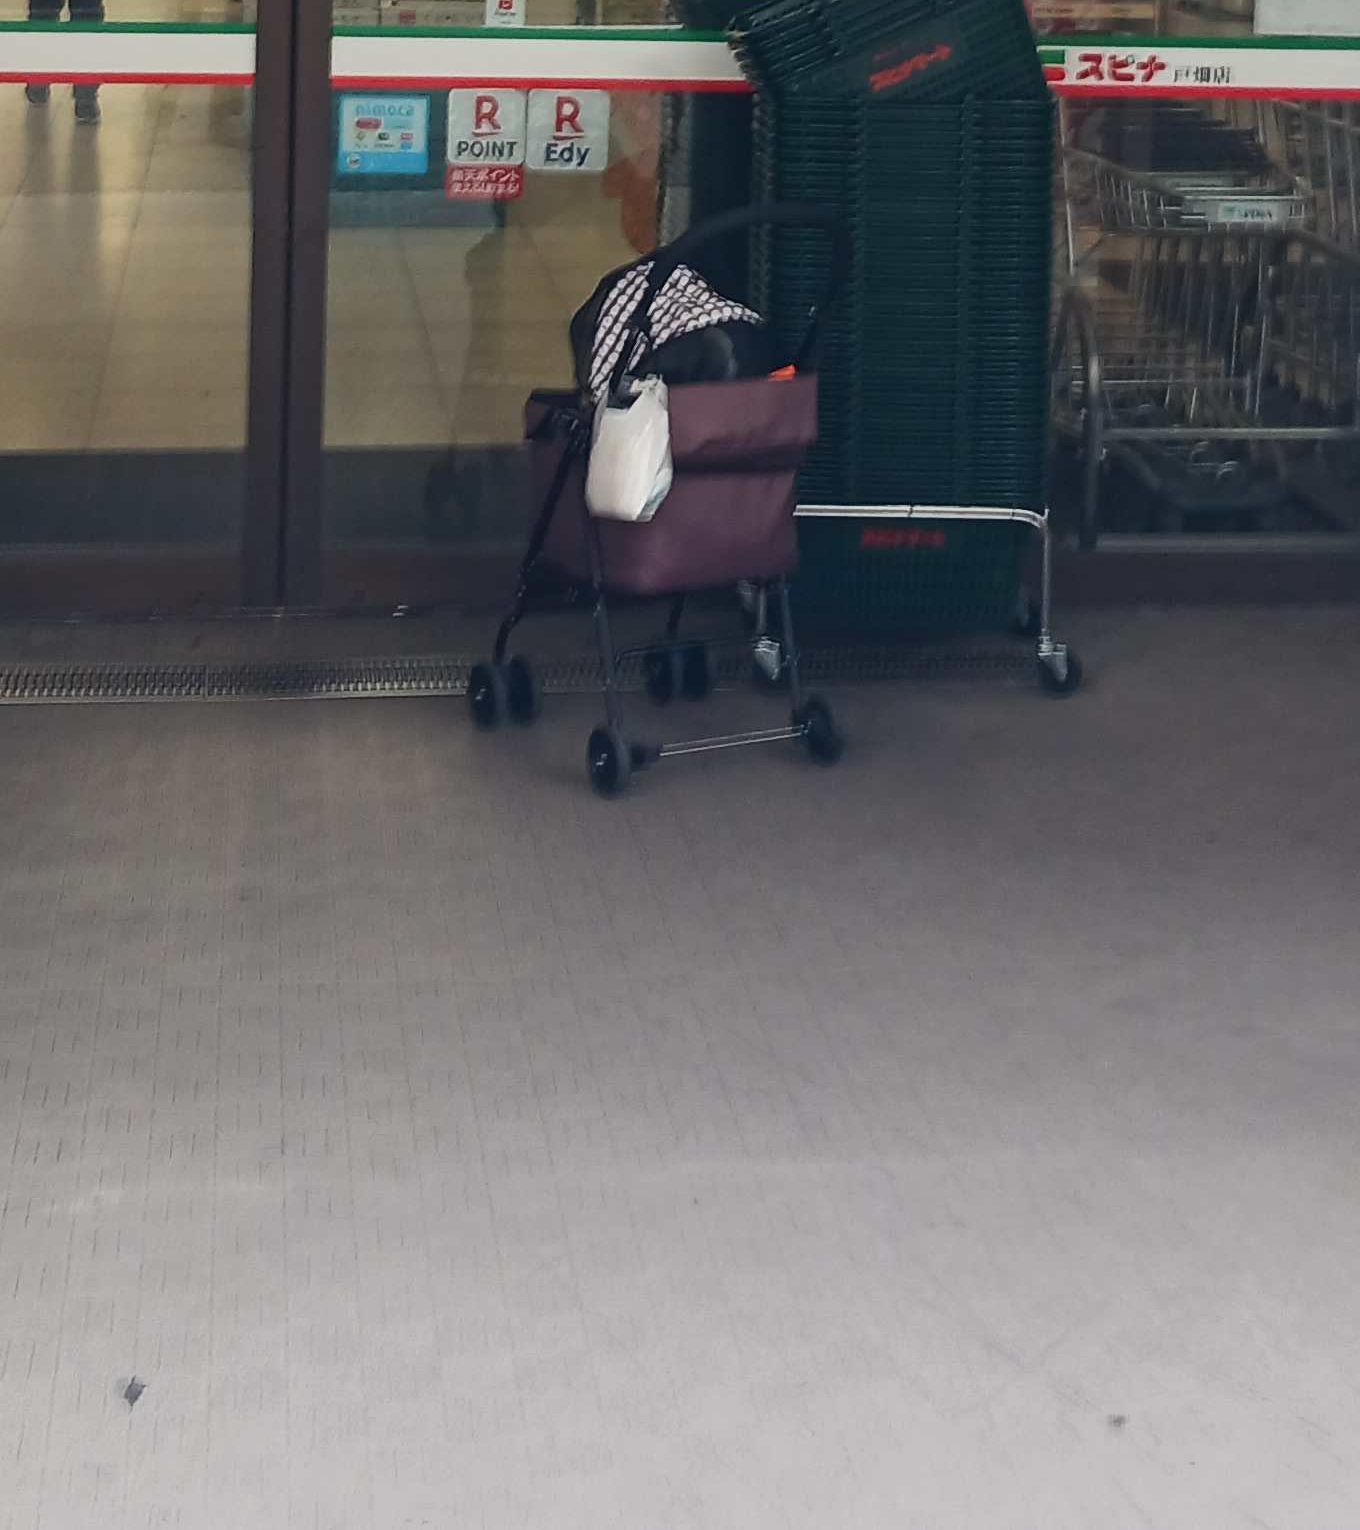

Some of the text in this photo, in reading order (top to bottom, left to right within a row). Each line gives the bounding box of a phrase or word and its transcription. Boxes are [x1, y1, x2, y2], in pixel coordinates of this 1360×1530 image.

[1075, 53, 1167, 83] スピナ
[474, 94, 502, 130] R
[554, 95, 585, 133] R
[456, 140, 518, 158] POINT
[544, 142, 590, 167] Edy
